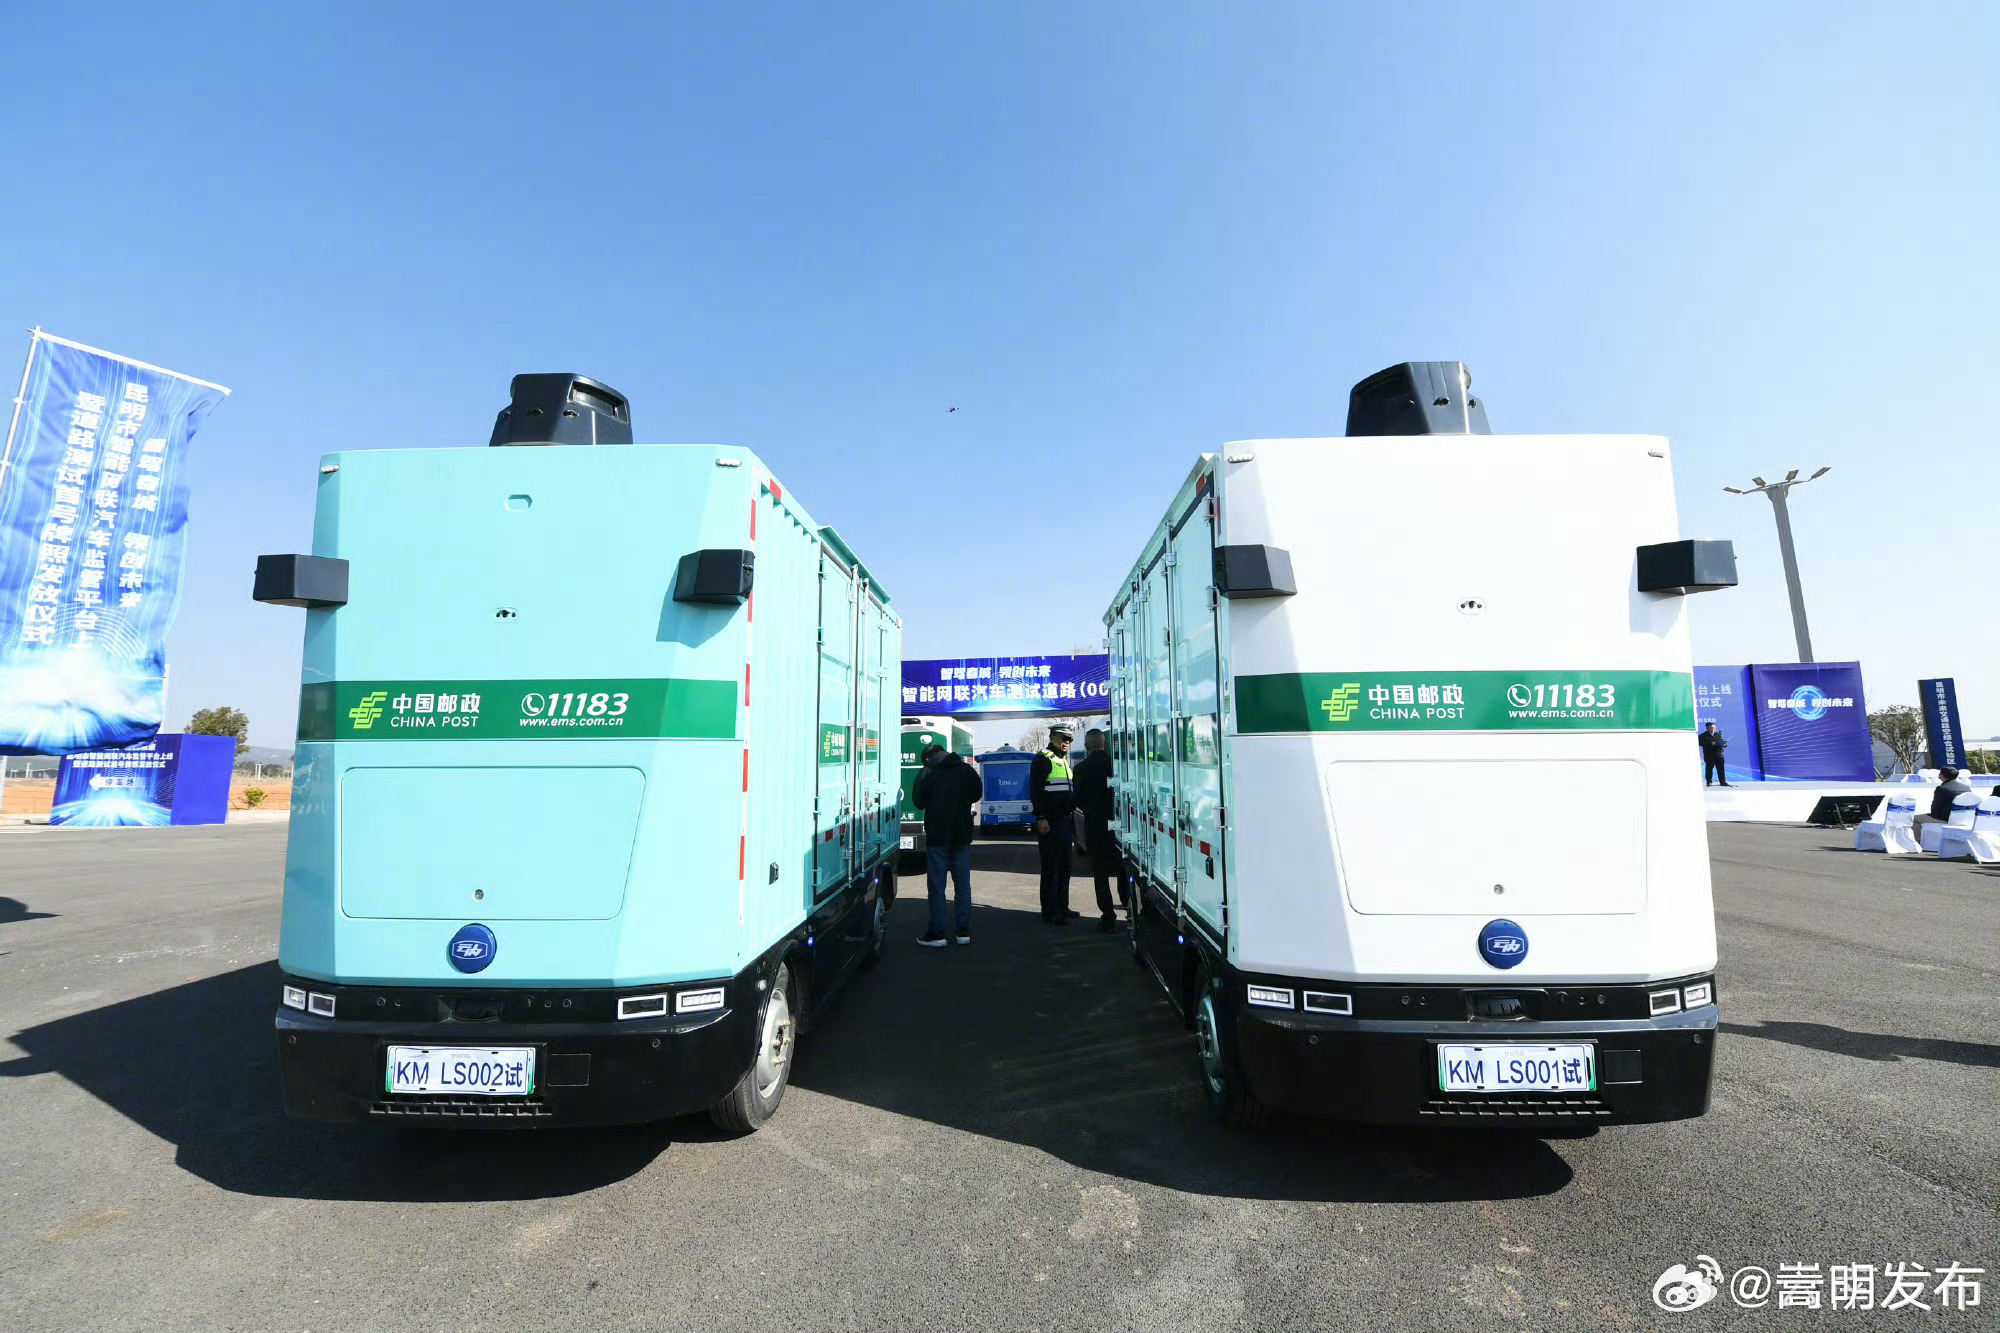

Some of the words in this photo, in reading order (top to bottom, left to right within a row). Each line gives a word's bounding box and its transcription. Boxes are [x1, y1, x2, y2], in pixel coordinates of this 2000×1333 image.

[940, 667, 992, 680] 智驾春城
[999, 665, 1052, 679] 领创未来
[1368, 684, 1465, 706] 中国邮政
[1533, 683, 1616, 708] 11183
[1694, 683, 1732, 696] 台上线
[392, 692, 481, 715] 中国邮政
[547, 692, 630, 716] 11183
[390, 715, 437, 729] CHINA
[441, 715, 480, 728] POST
[1369, 707, 1420, 719] CHINA
[1426, 707, 1465, 719] POST
[1508, 709, 1615, 720] www.ems.com.cn
[519, 717, 625, 729] www.ems.com.cn
[397, 1061, 430, 1085] KM
[441, 1062, 524, 1088] LS002试
[1448, 1060, 1485, 1084] KM
[1496, 1058, 1583, 1085] LS001试
